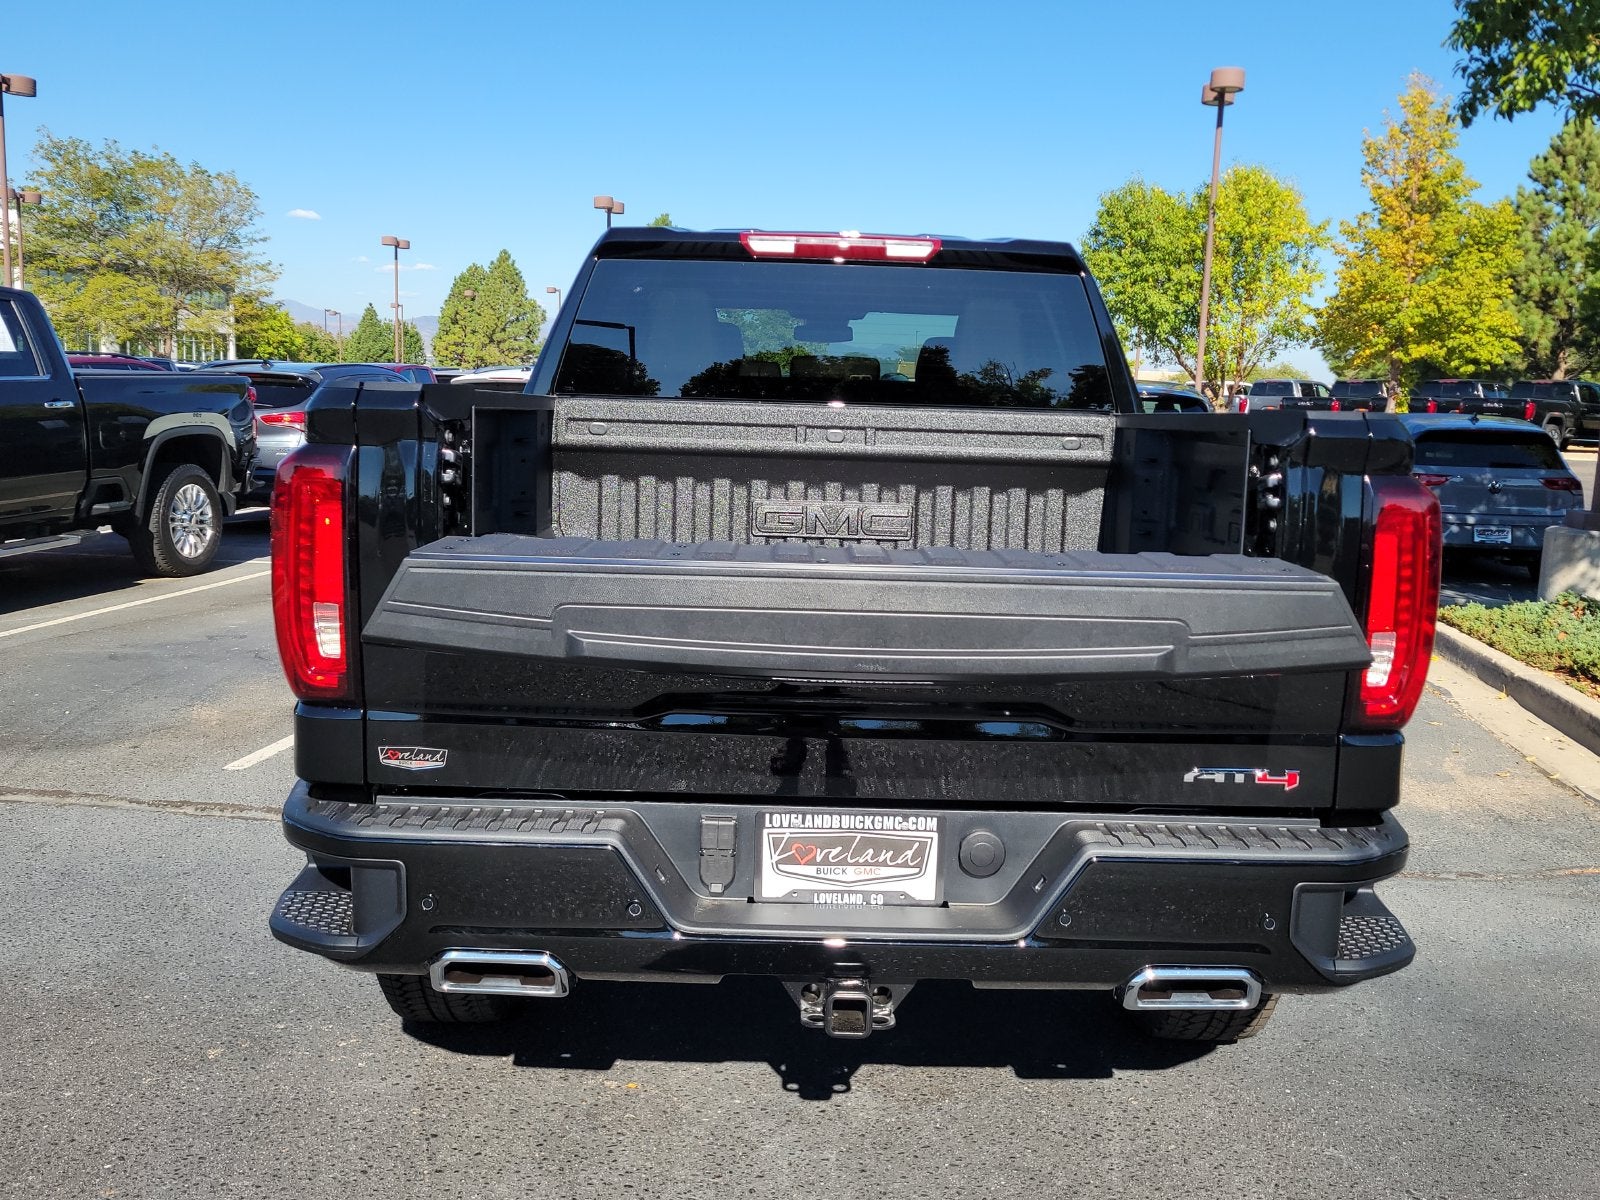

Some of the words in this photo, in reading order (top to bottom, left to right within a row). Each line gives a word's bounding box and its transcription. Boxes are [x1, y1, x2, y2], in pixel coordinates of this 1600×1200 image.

[755, 504, 909, 538] GMC
[1183, 767, 1299, 791] AT4
[765, 813, 938, 831] LOVELANDBUICKGMC.COM
[771, 832, 921, 866] Loveland
[816, 867, 848, 876] BUICK
[853, 868, 881, 876] GMC
[814, 893, 867, 905] LOVELAND,
[870, 894, 884, 905] CO
